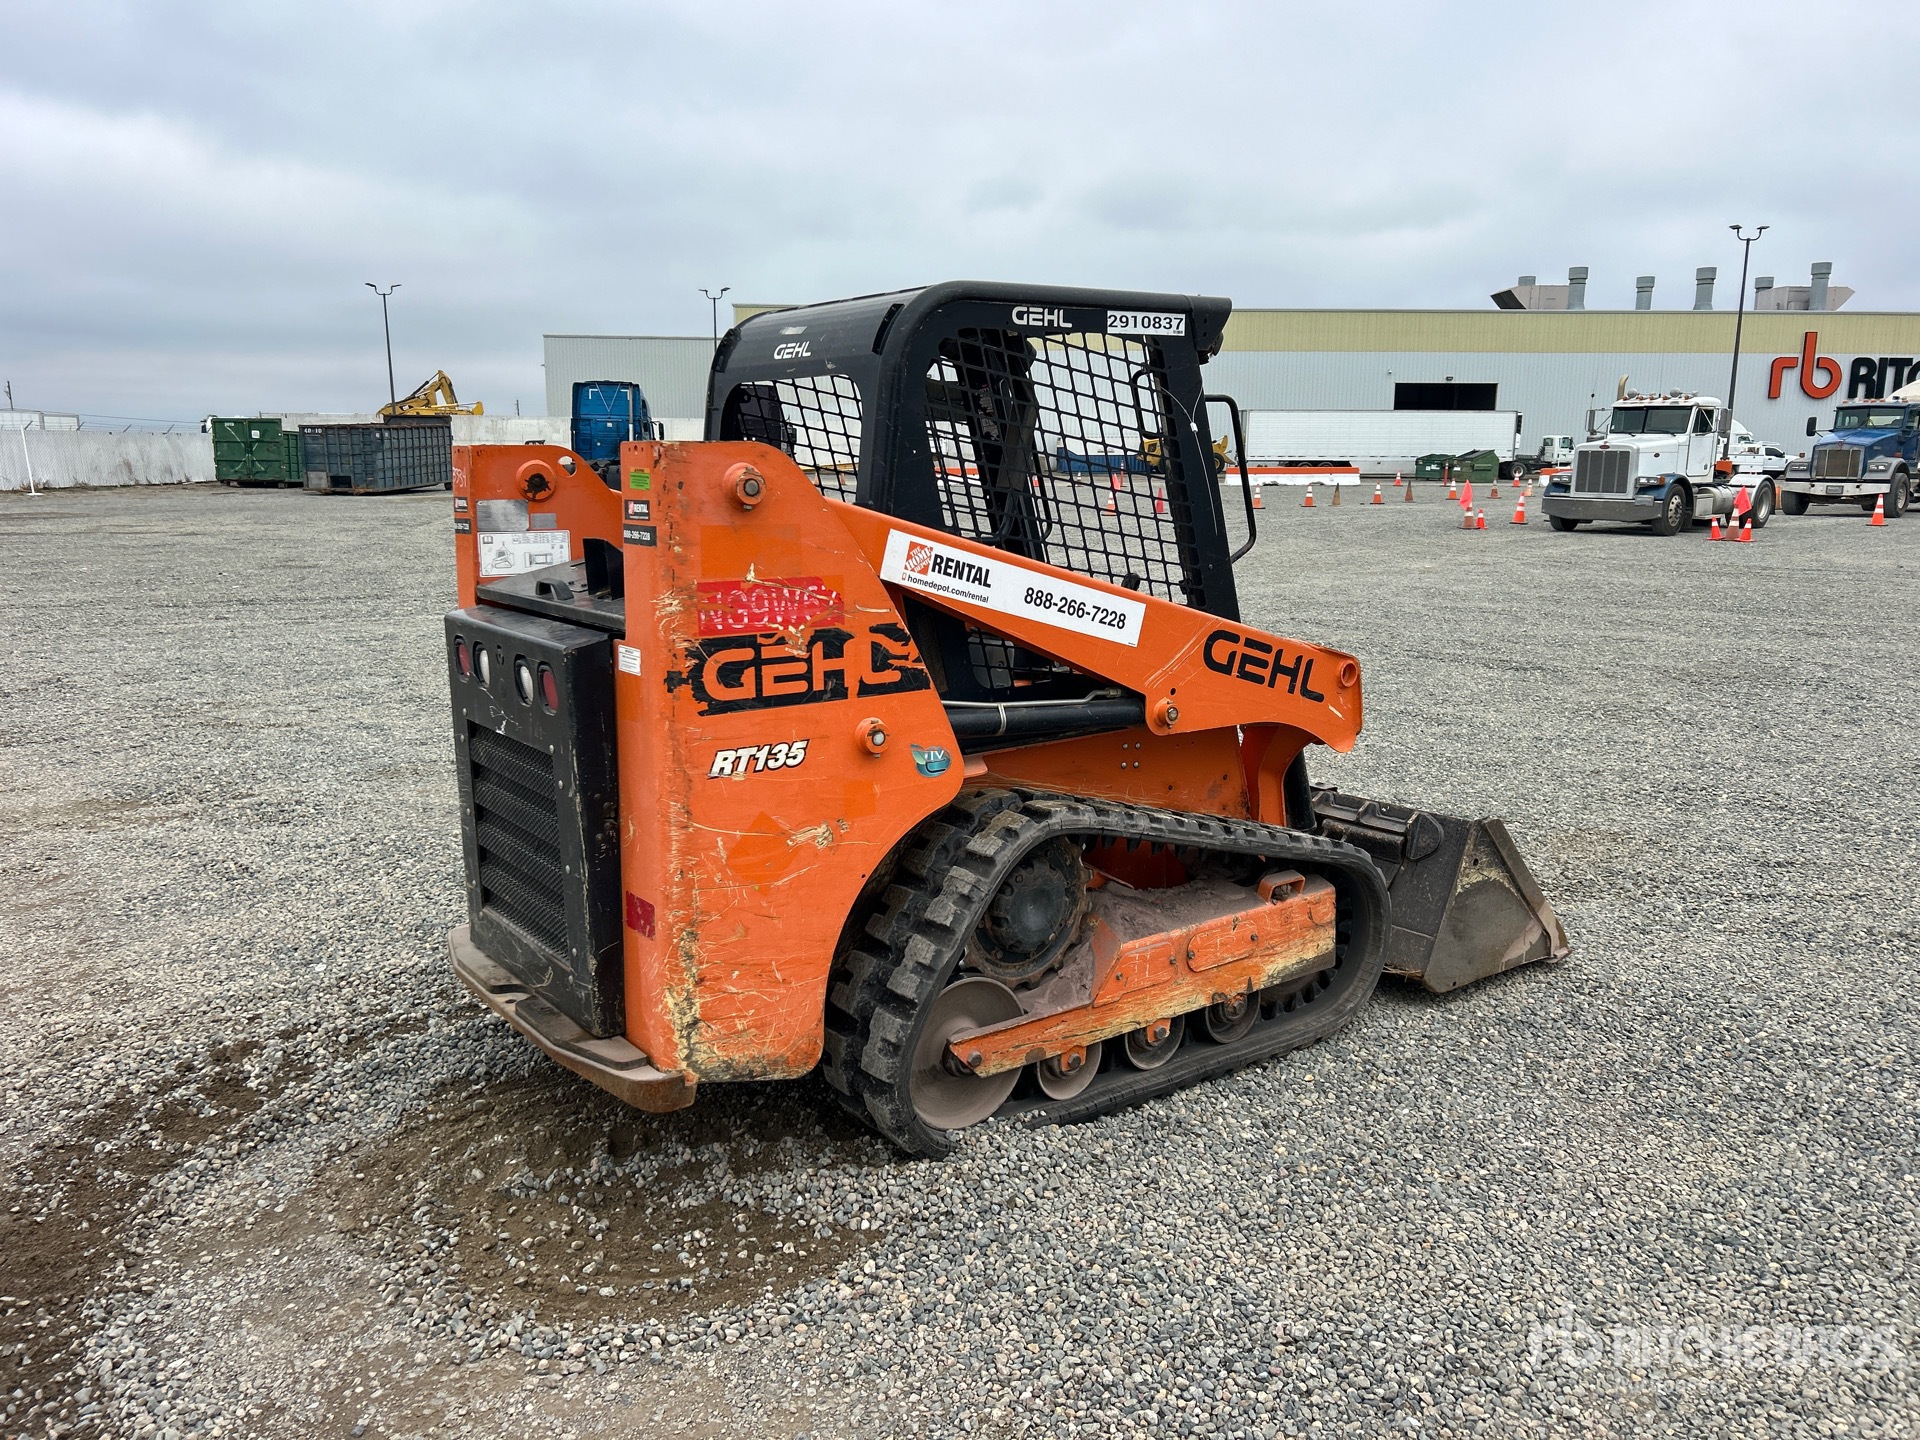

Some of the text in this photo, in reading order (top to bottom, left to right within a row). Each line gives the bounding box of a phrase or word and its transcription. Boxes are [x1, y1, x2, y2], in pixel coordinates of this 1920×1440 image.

[1012, 306, 1072, 328] GEHL
[1108, 314, 1184, 331] 2910837
[774, 341, 811, 360] GEHL
[1768, 332, 1842, 399] rb
[904, 546, 932, 571] HOME
[931, 553, 992, 588] RENTAL
[907, 575, 989, 603] homedepot.com/rental
[1024, 587, 1126, 630] 888-266-7228
[1203, 629, 1325, 703] GEHL
[708, 740, 809, 779] RT135
